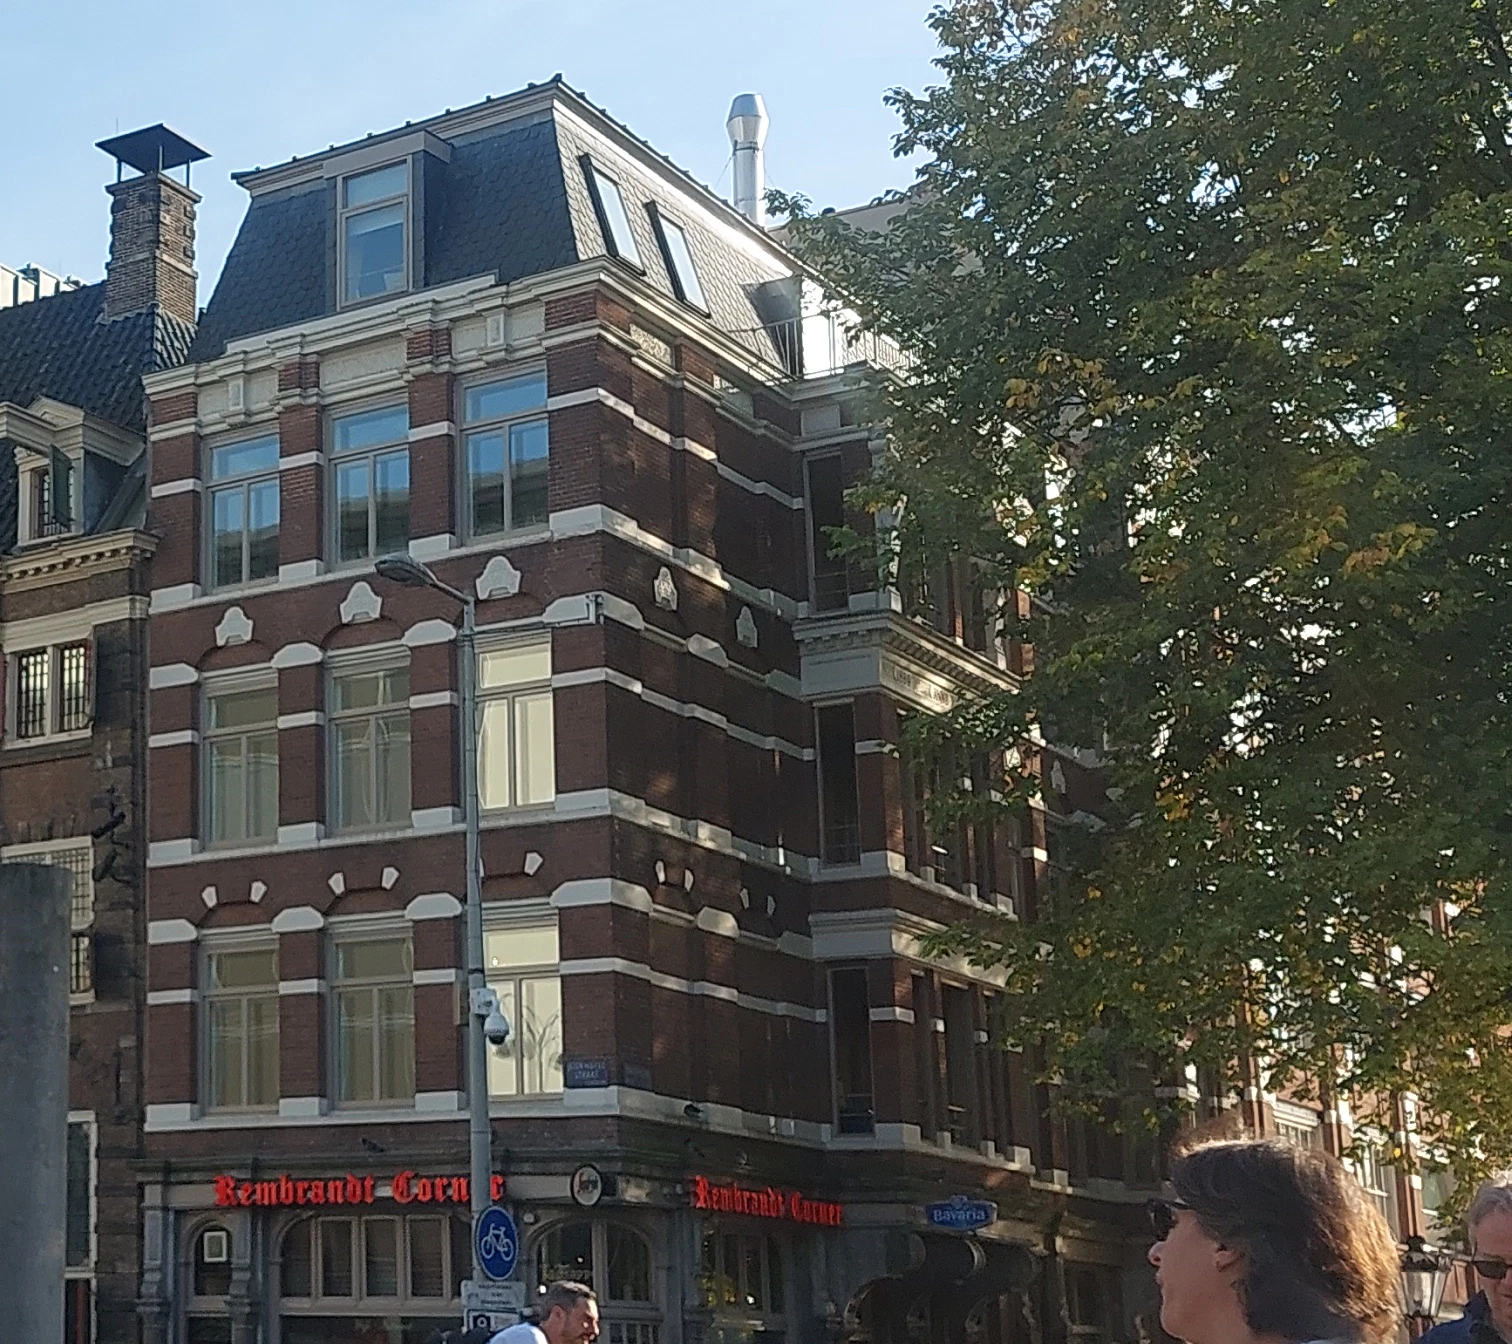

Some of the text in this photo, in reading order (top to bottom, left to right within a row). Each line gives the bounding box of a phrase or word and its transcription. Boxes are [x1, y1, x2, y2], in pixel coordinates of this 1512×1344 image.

[213, 1170, 504, 1206] Rembrandt Cornr
[695, 1174, 842, 1225] Rembrandt Corner
[933, 1207, 986, 1222] Bavaria
